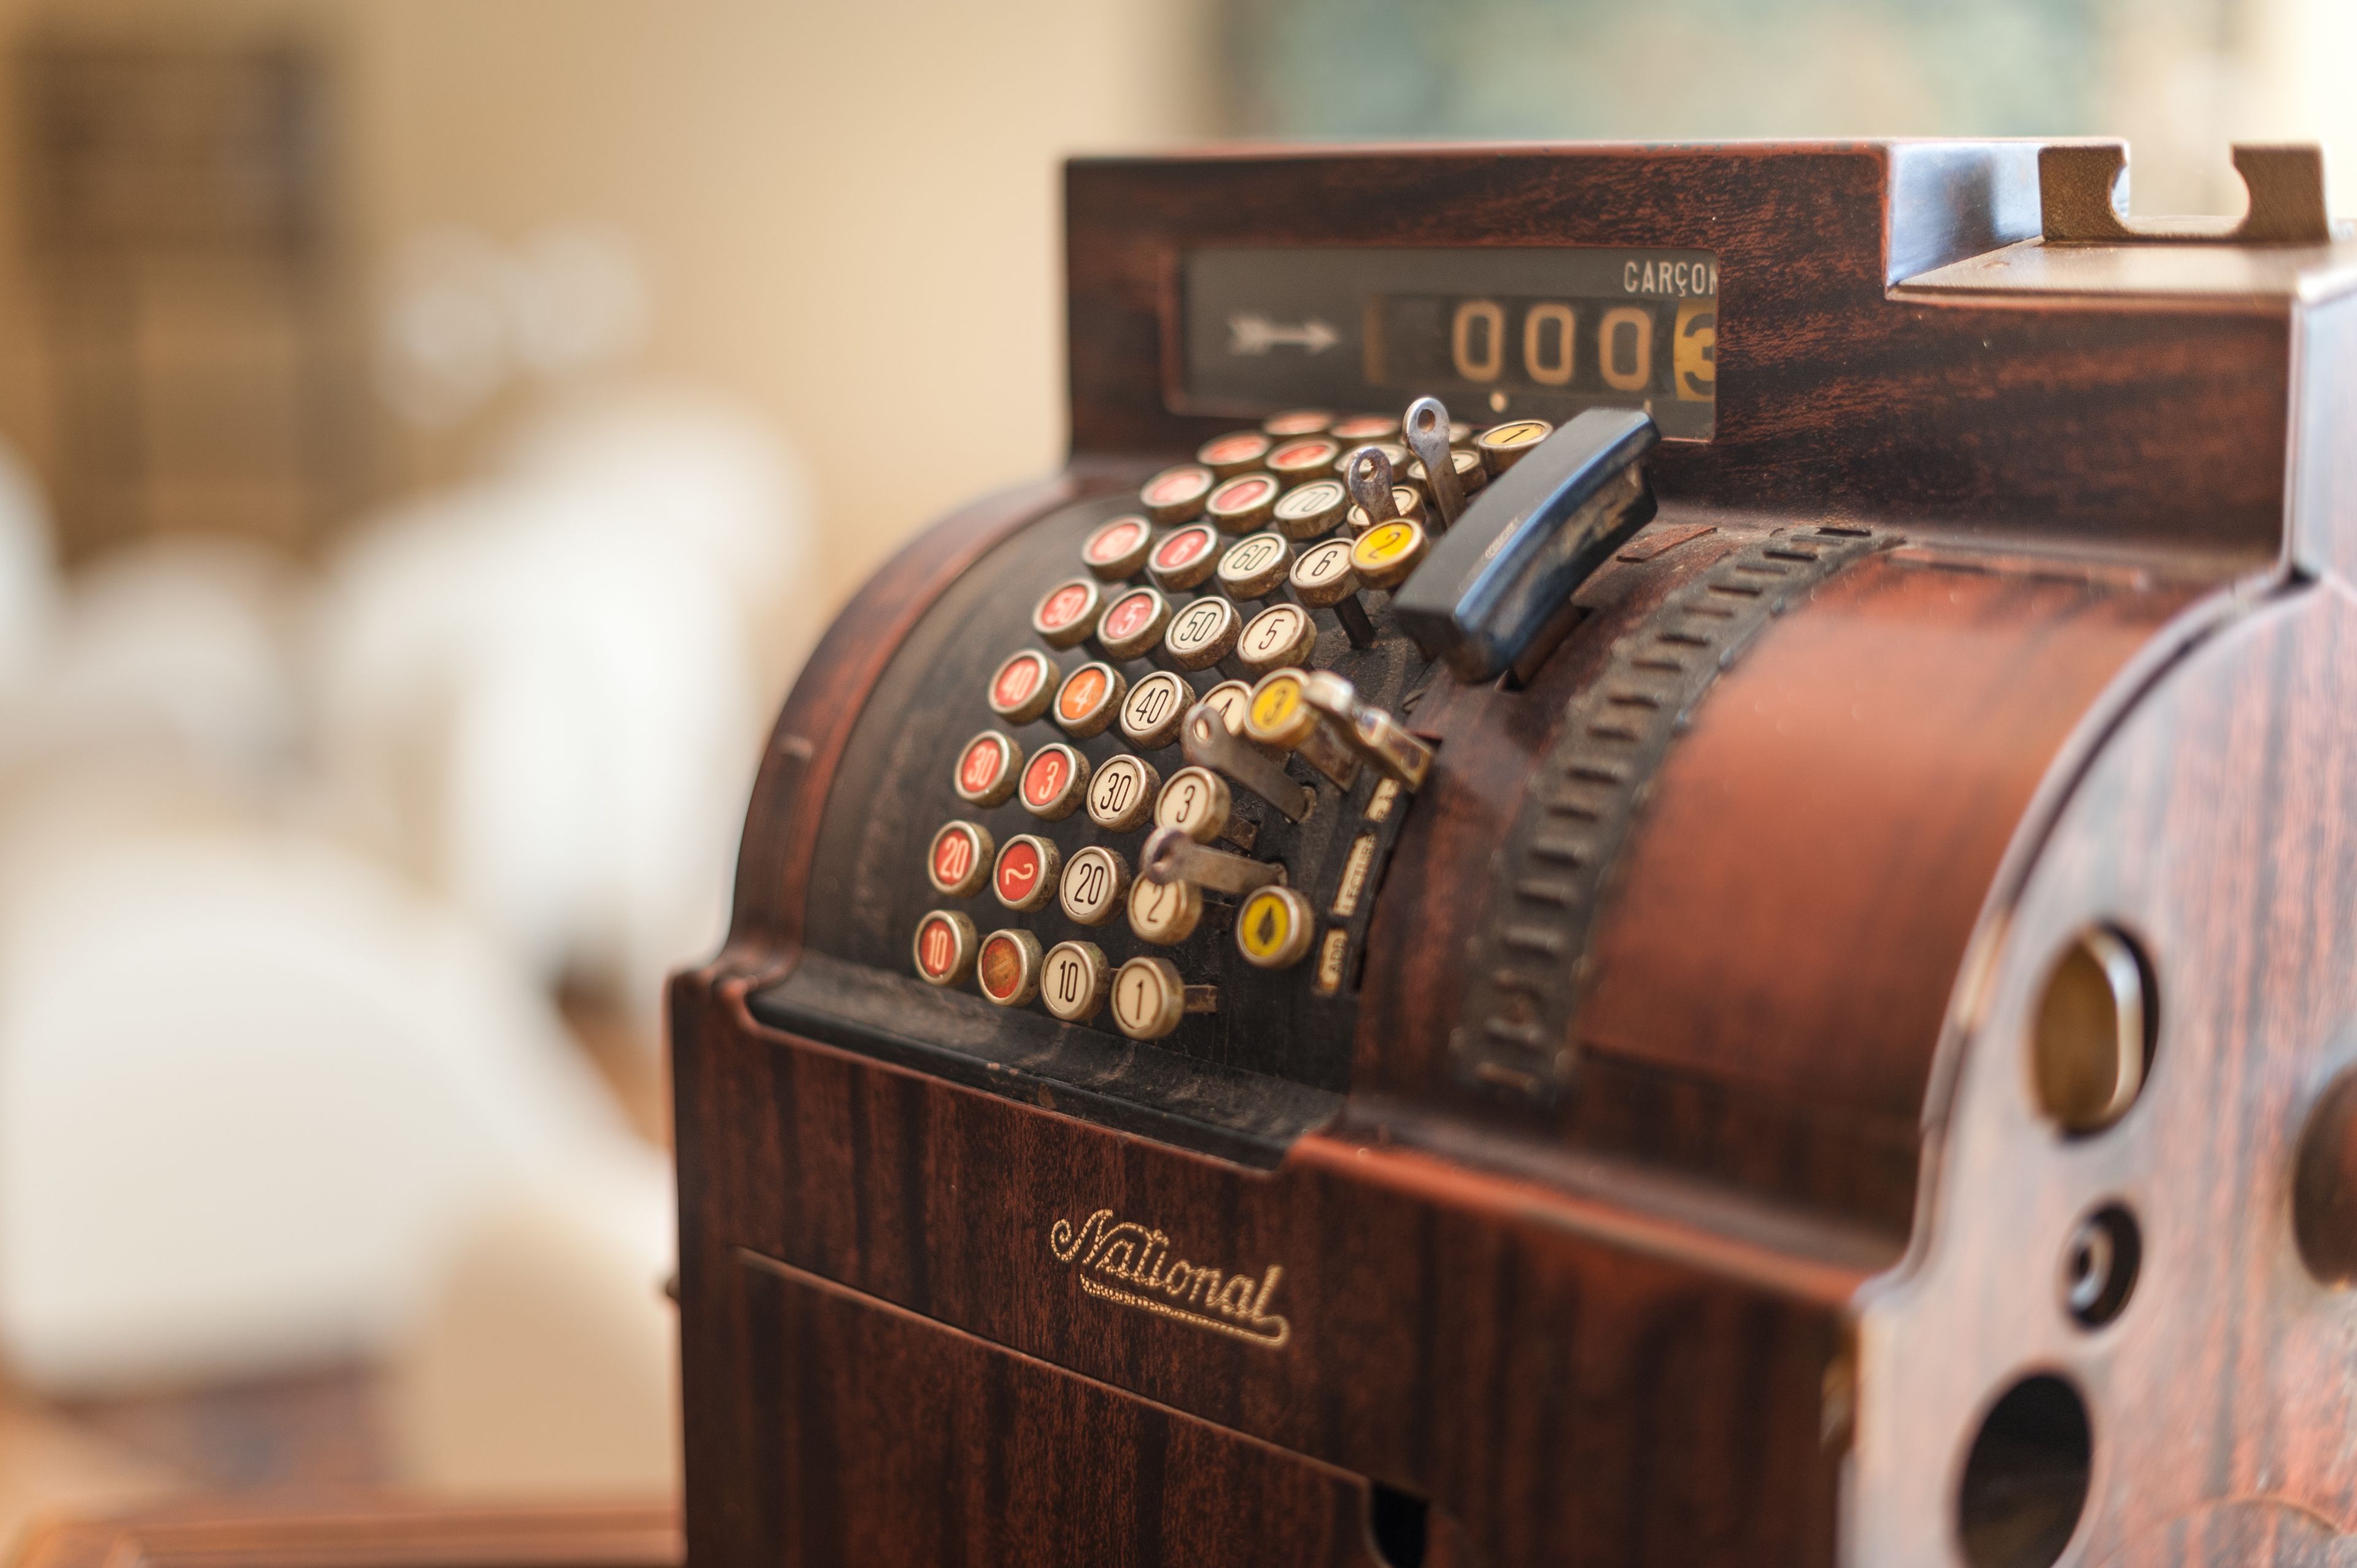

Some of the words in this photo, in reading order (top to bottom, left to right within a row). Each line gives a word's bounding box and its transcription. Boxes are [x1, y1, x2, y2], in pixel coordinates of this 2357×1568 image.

[1501, 428, 1531, 444] 1
[1289, 492, 1330, 513] 70
[1168, 536, 1198, 565] 6
[1231, 544, 1272, 571] 60
[1310, 550, 1338, 577] 6
[1367, 531, 1401, 560] 2
[1116, 602, 1145, 635] 5
[1179, 611, 1217, 643] 50
[1258, 619, 1285, 650] 5
[1001, 663, 1037, 702] 40
[1074, 676, 1097, 713] 4
[1135, 687, 1170, 725] 40
[1263, 686, 1287, 725] 3
[966, 745, 999, 787] 30
[1038, 760, 1059, 800] 3
[1099, 771, 1132, 813] 30
[1176, 784, 1196, 823] 3
[939, 836, 970, 879] 20
[1005, 863, 1034, 885] 2
[1073, 862, 1105, 906] 20
[1147, 883, 1166, 923] 2
[929, 929, 949, 971] 10
[1058, 959, 1079, 1003] 10
[1135, 978, 1145, 1021] 1
[1051, 1208, 1290, 1346] National
